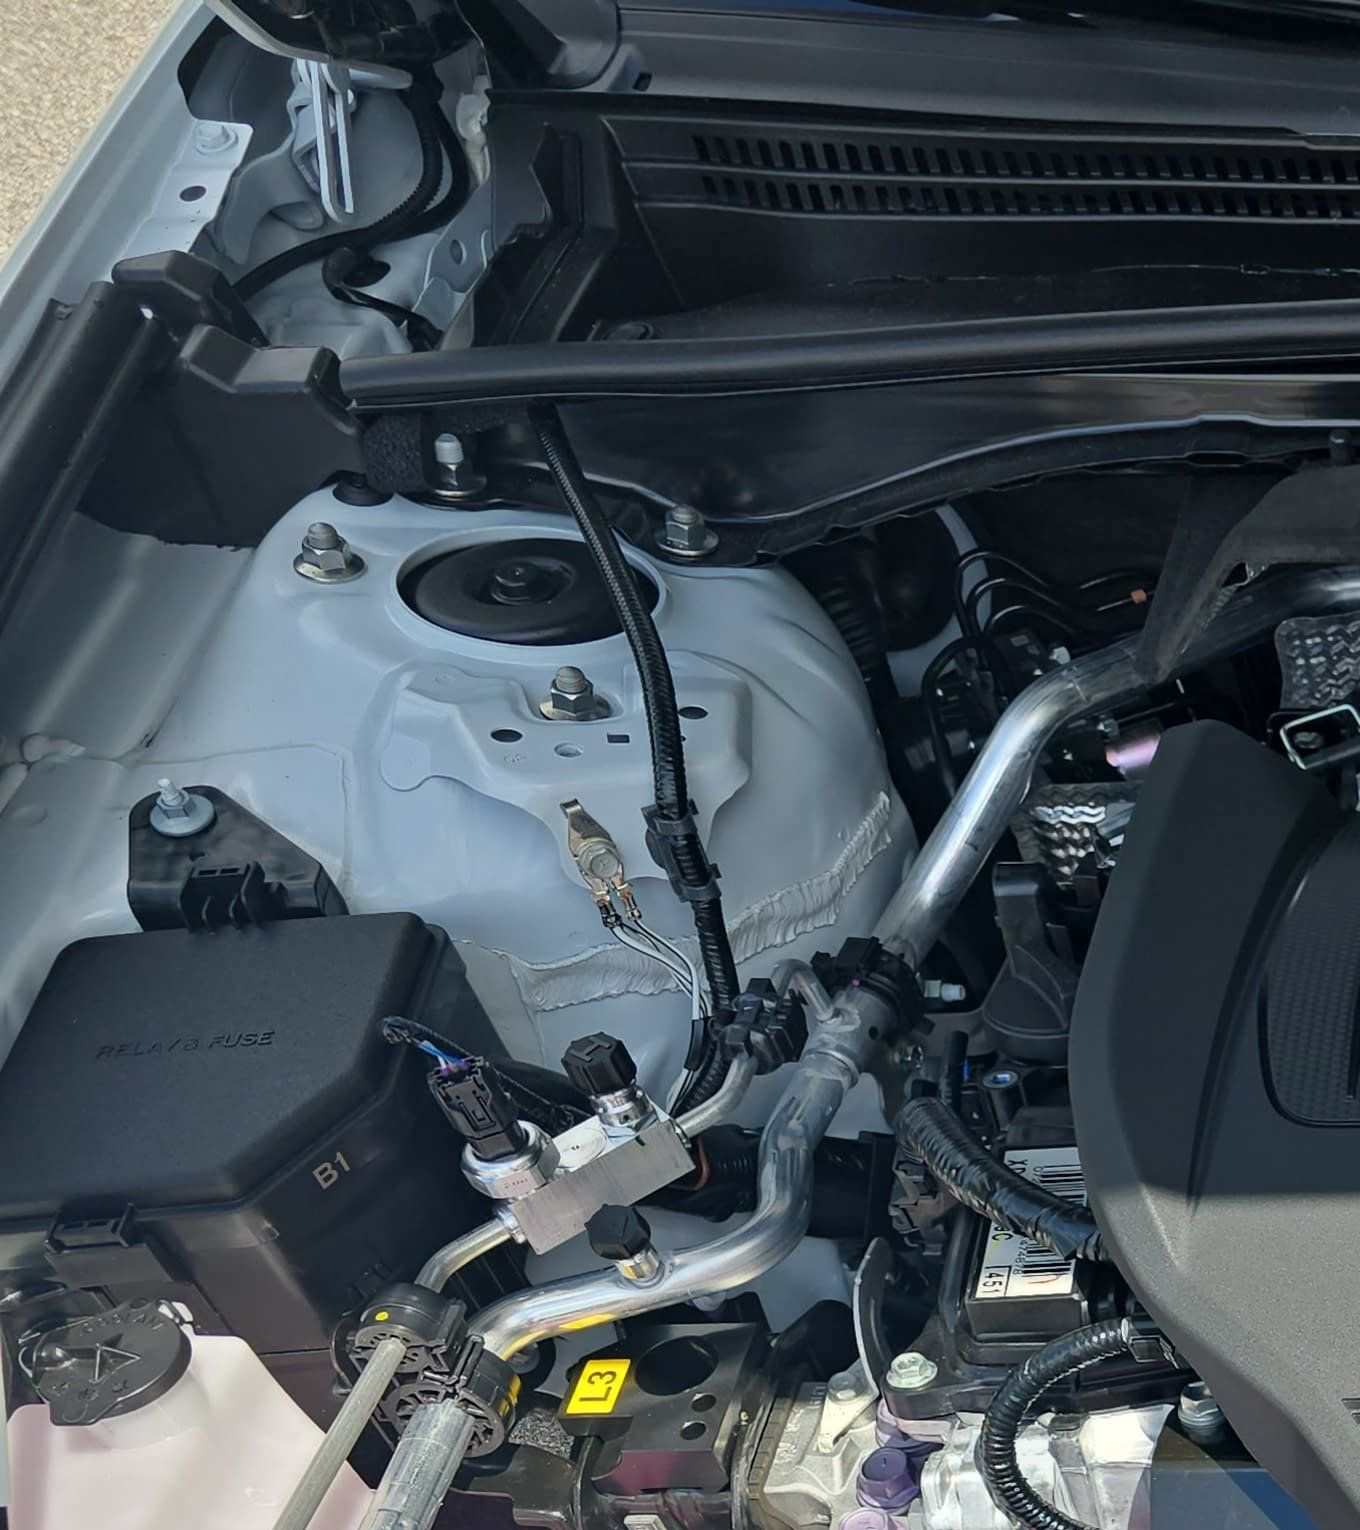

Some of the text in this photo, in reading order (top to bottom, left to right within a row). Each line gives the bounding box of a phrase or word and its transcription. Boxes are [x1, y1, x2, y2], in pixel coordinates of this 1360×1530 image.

[207, 1029, 276, 1050] FUSE
[311, 1150, 351, 1190] B1
[578, 1370, 618, 1402] L3
